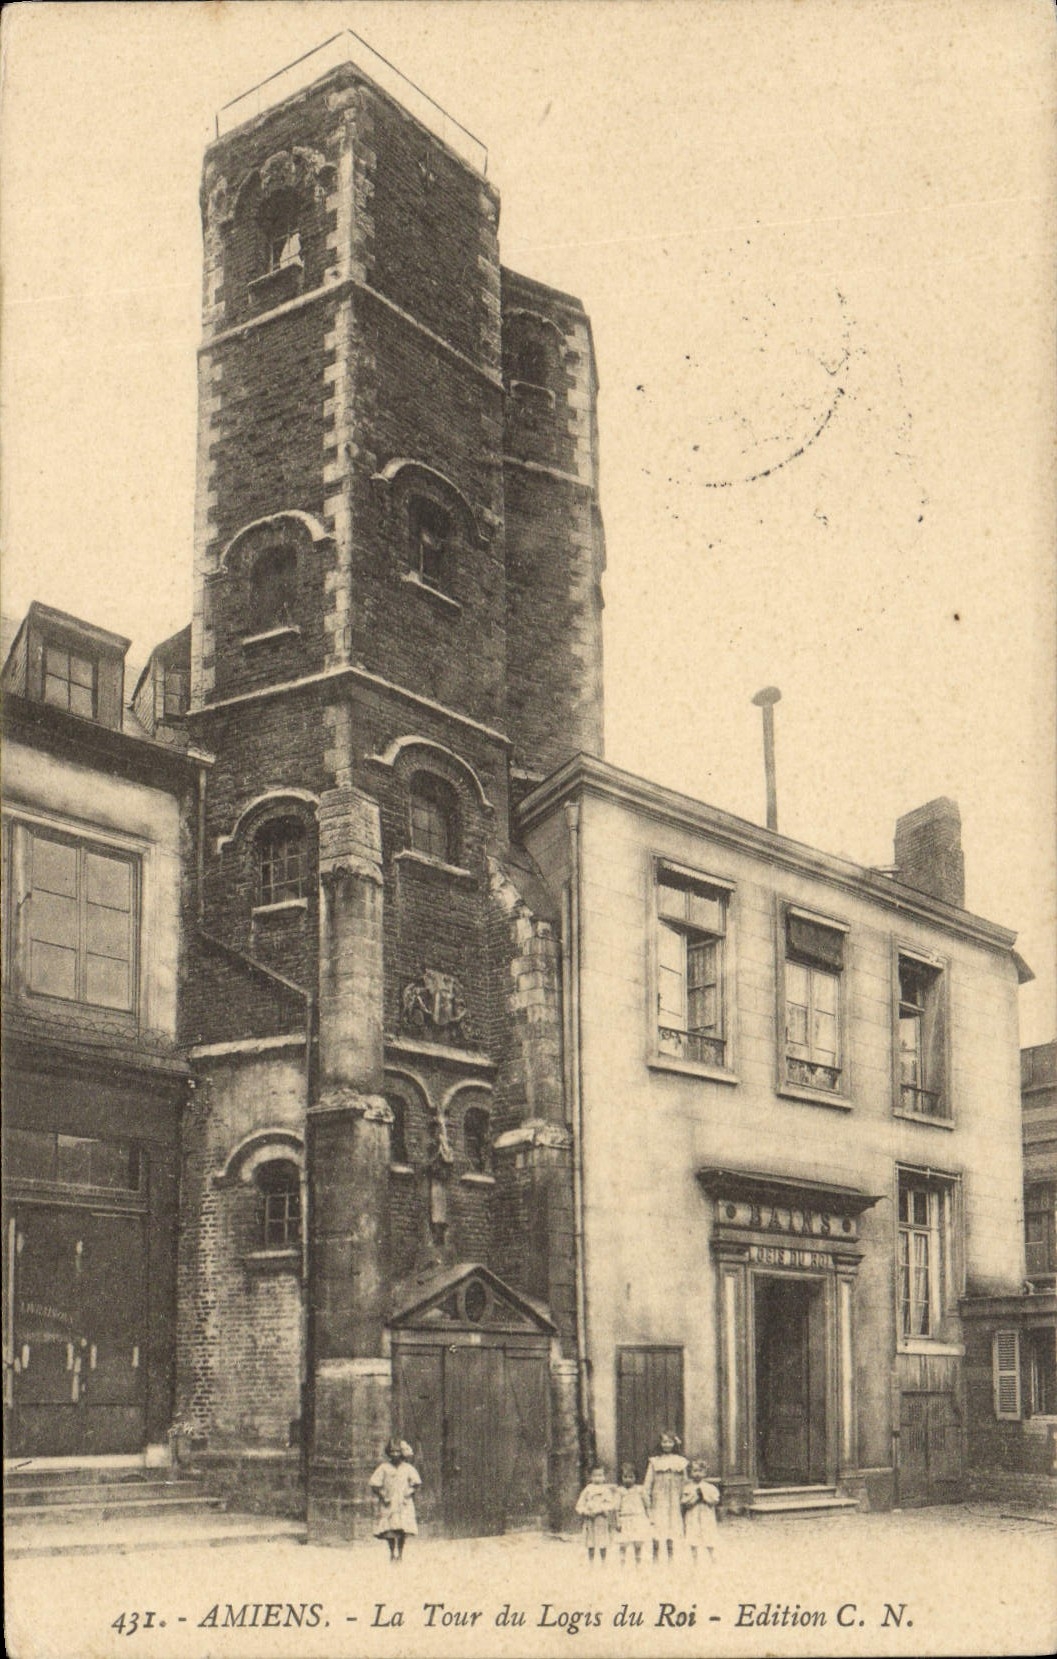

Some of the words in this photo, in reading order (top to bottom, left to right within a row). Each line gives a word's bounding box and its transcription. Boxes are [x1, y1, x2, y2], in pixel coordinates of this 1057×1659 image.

[749, 1204, 831, 1236] BAINS
[748, 1246, 785, 1265] LOGIS
[790, 1248, 805, 1267] DU
